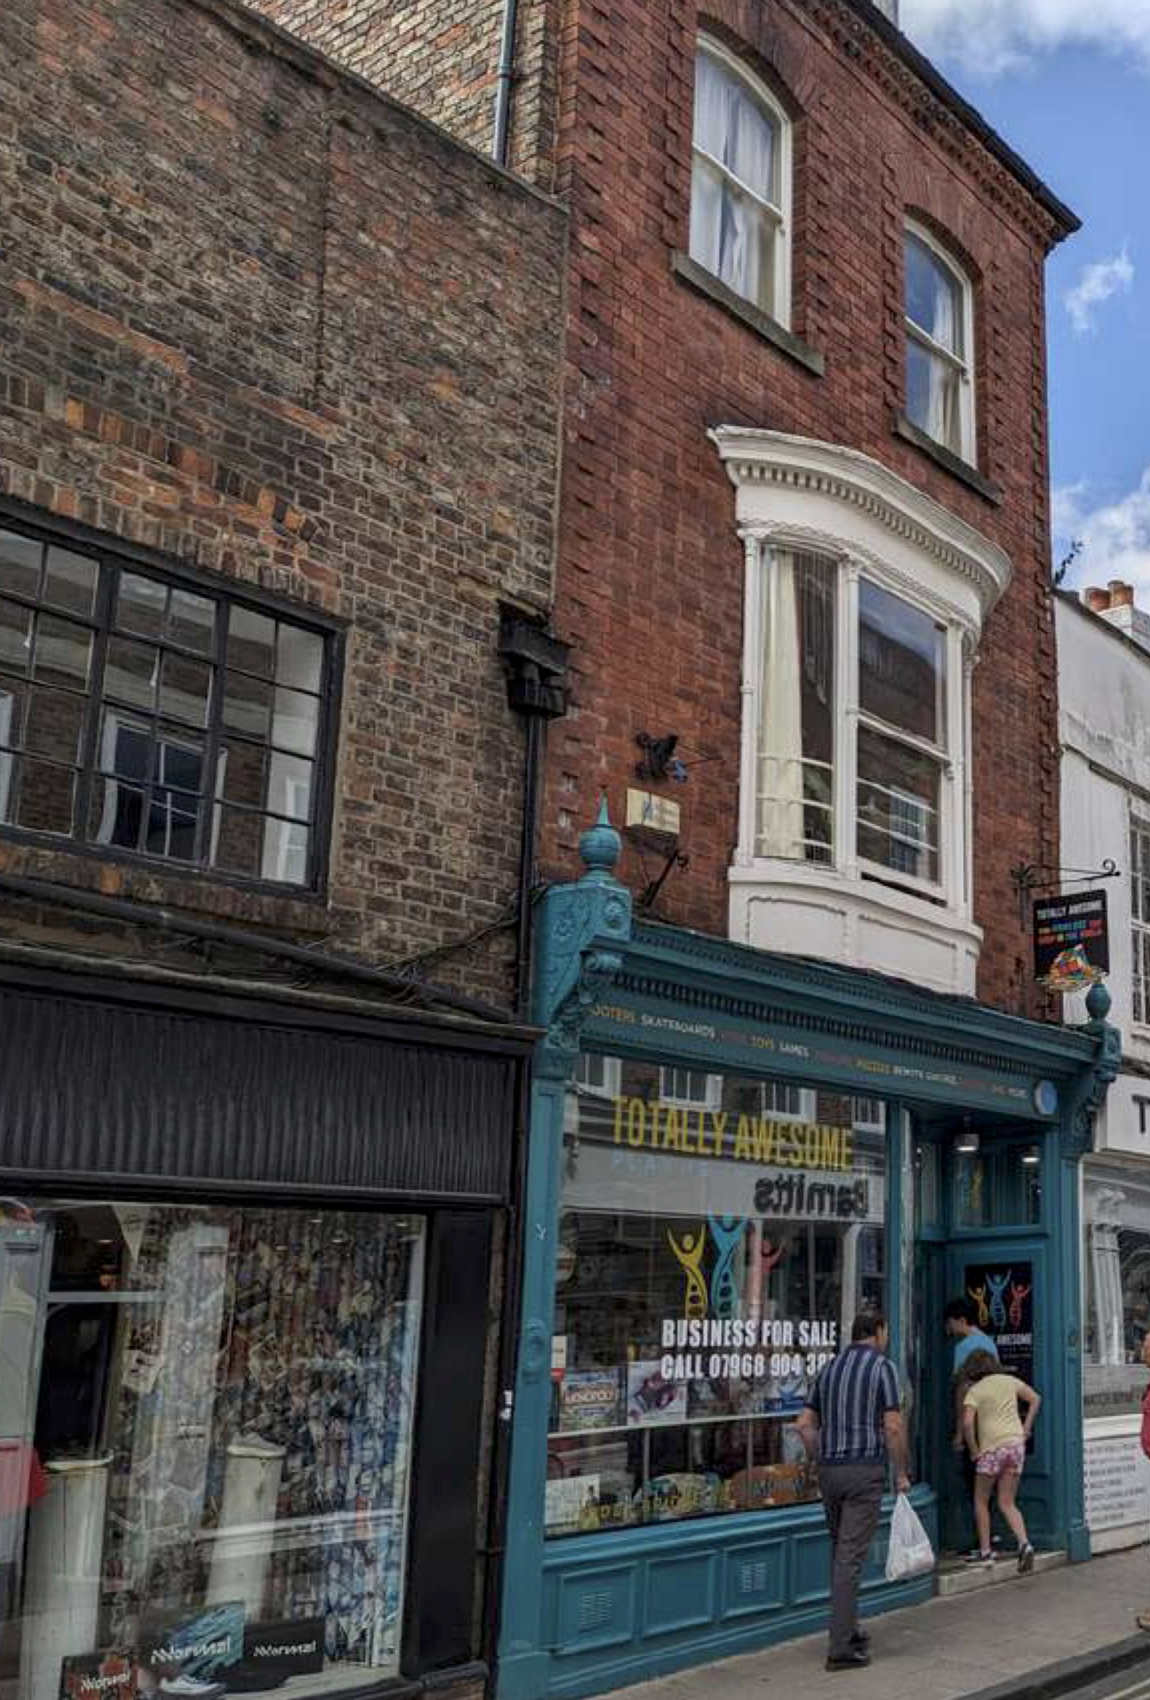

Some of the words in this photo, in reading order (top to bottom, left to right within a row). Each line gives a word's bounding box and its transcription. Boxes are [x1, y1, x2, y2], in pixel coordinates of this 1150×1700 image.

[640, 1014, 716, 1039] SKATEBOARDS
[612, 1095, 728, 1157] TOTALLY
[733, 1113, 853, 1171] AWESOME
[661, 1318, 758, 1348] BUSINESS
[760, 1319, 794, 1347] FOR
[799, 1319, 837, 1347] SALE
[660, 1352, 705, 1380] CALL
[708, 1352, 765, 1379] 07968
[770, 1352, 801, 1378] 904
